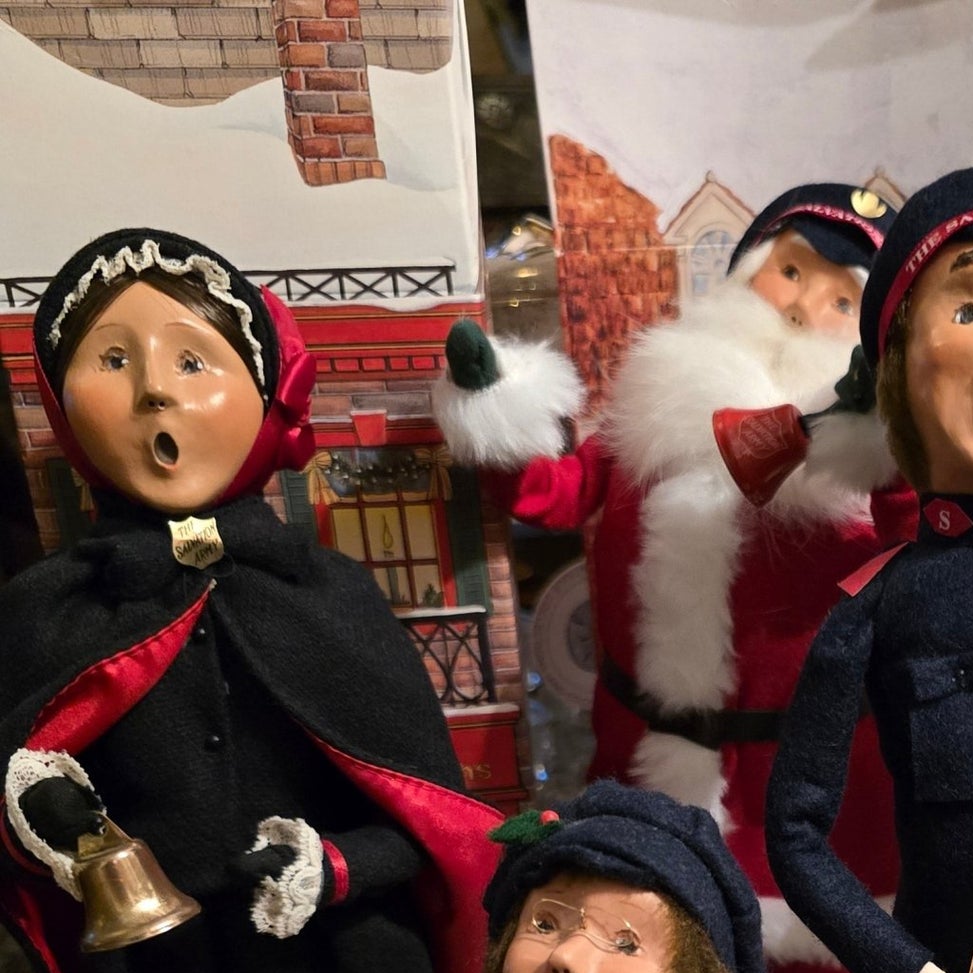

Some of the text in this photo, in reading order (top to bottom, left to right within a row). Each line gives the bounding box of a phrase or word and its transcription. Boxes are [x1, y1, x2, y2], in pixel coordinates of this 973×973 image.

[906, 232, 942, 273] THE
[939, 510, 951, 531] S
[194, 538, 218, 566] ARMY
